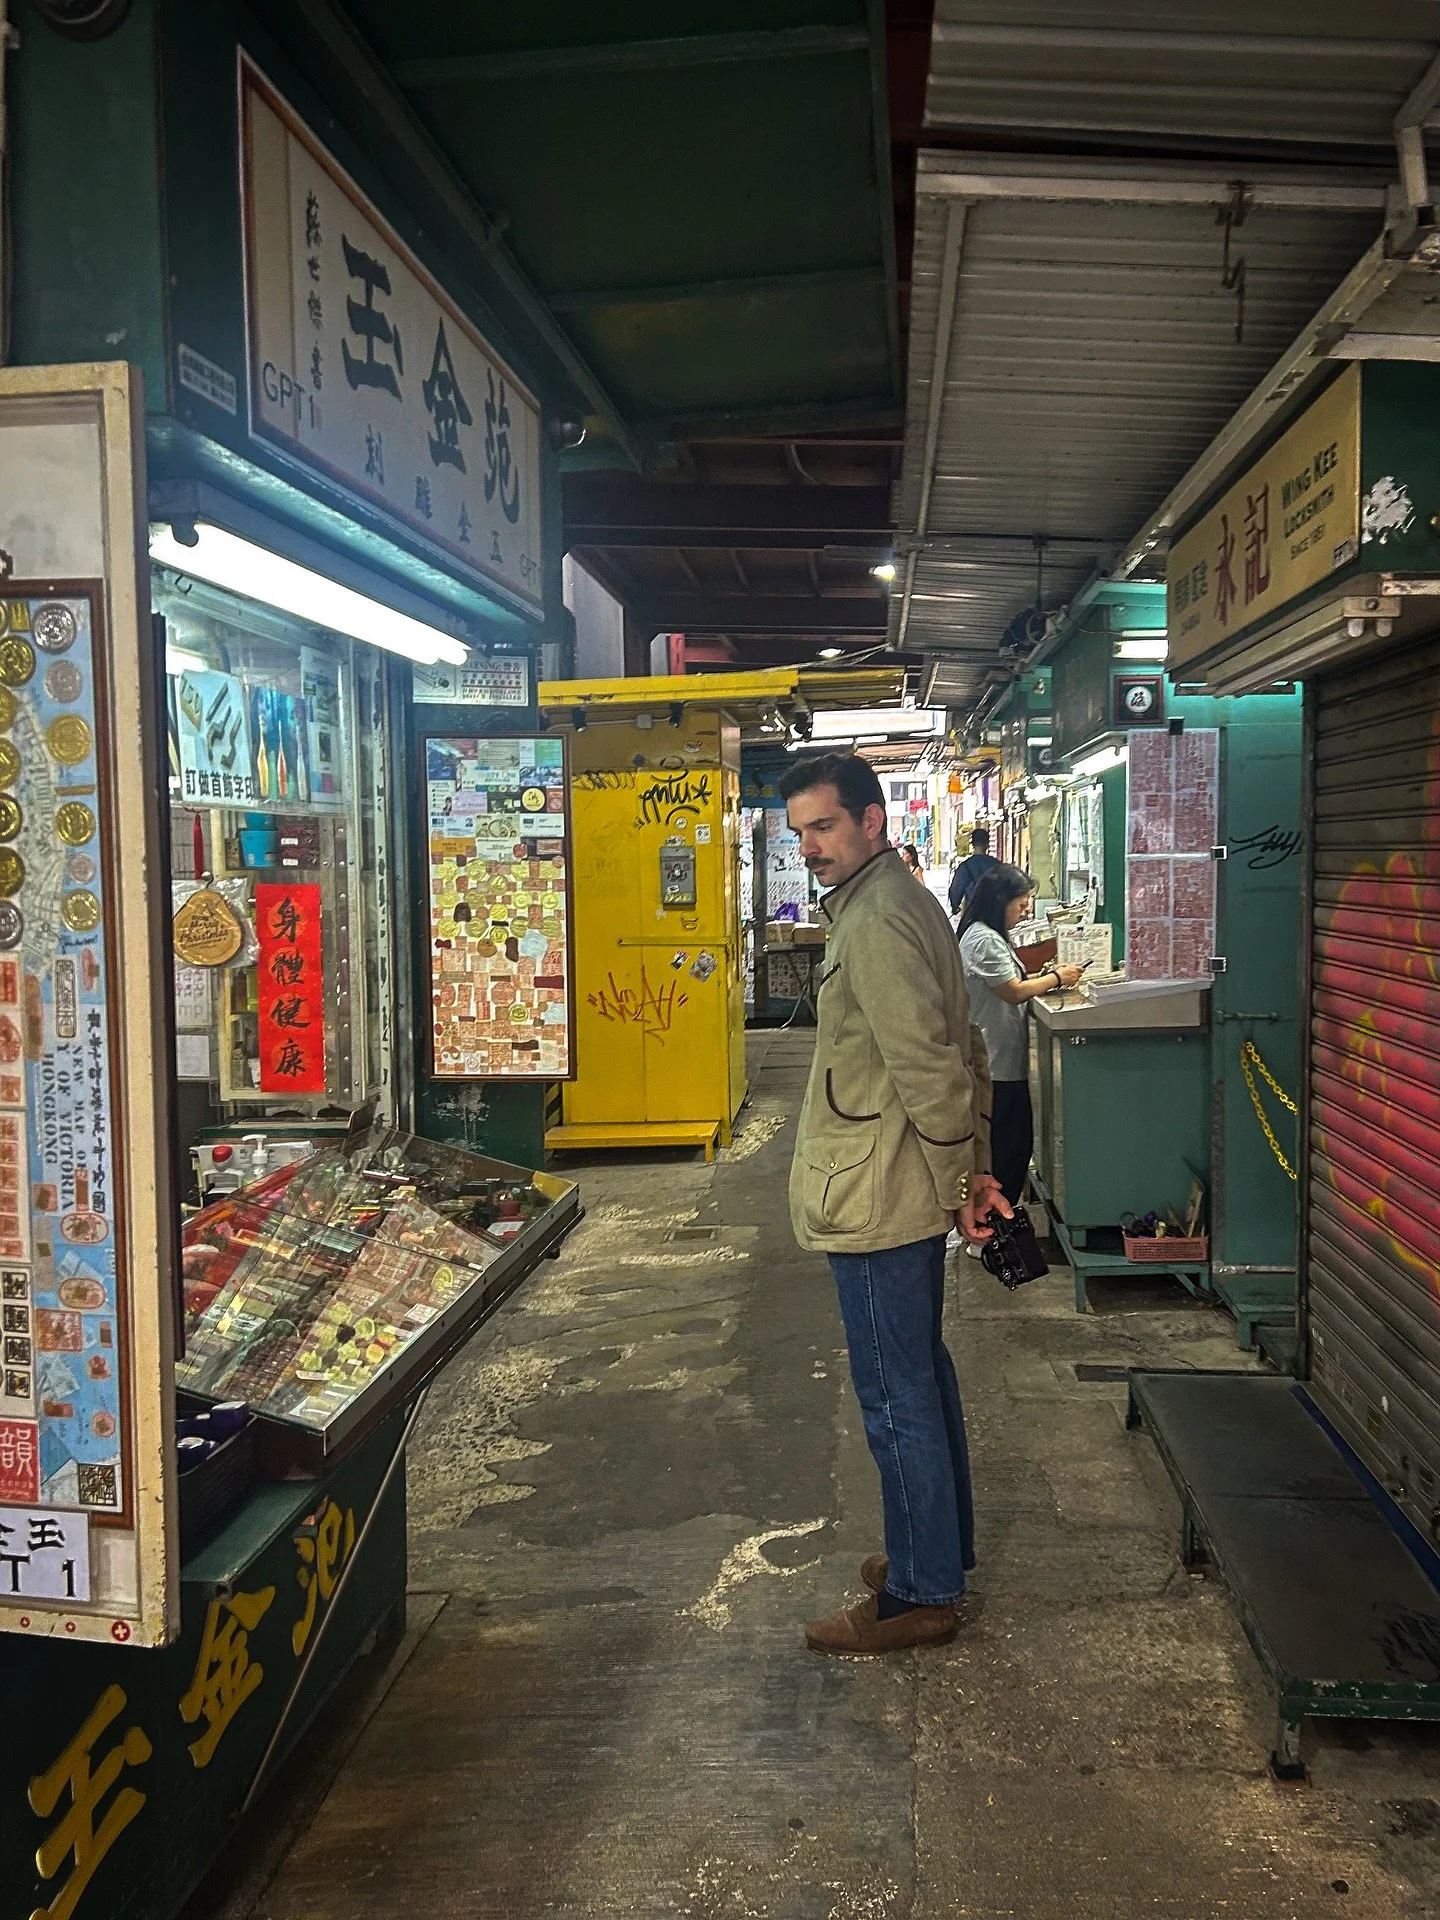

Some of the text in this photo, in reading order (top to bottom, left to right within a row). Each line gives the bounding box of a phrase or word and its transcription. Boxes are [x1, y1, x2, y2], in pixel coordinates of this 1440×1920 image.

[263, 361, 306, 421] GPT
[1281, 441, 1339, 510] WING KEE
[1284, 483, 1336, 539] LOCKSMITH
[179, 928, 229, 944] Christmas
[271, 897, 312, 1078] 身體健康
[57, 1070, 71, 1097] OF
[72, 1045, 84, 1084] NEW
[42, 1053, 58, 1164] HONGKONG
[74, 1100, 85, 1134] MAP
[59, 1110, 75, 1210] VICTORIA
[61, 1559, 76, 1598] 1
